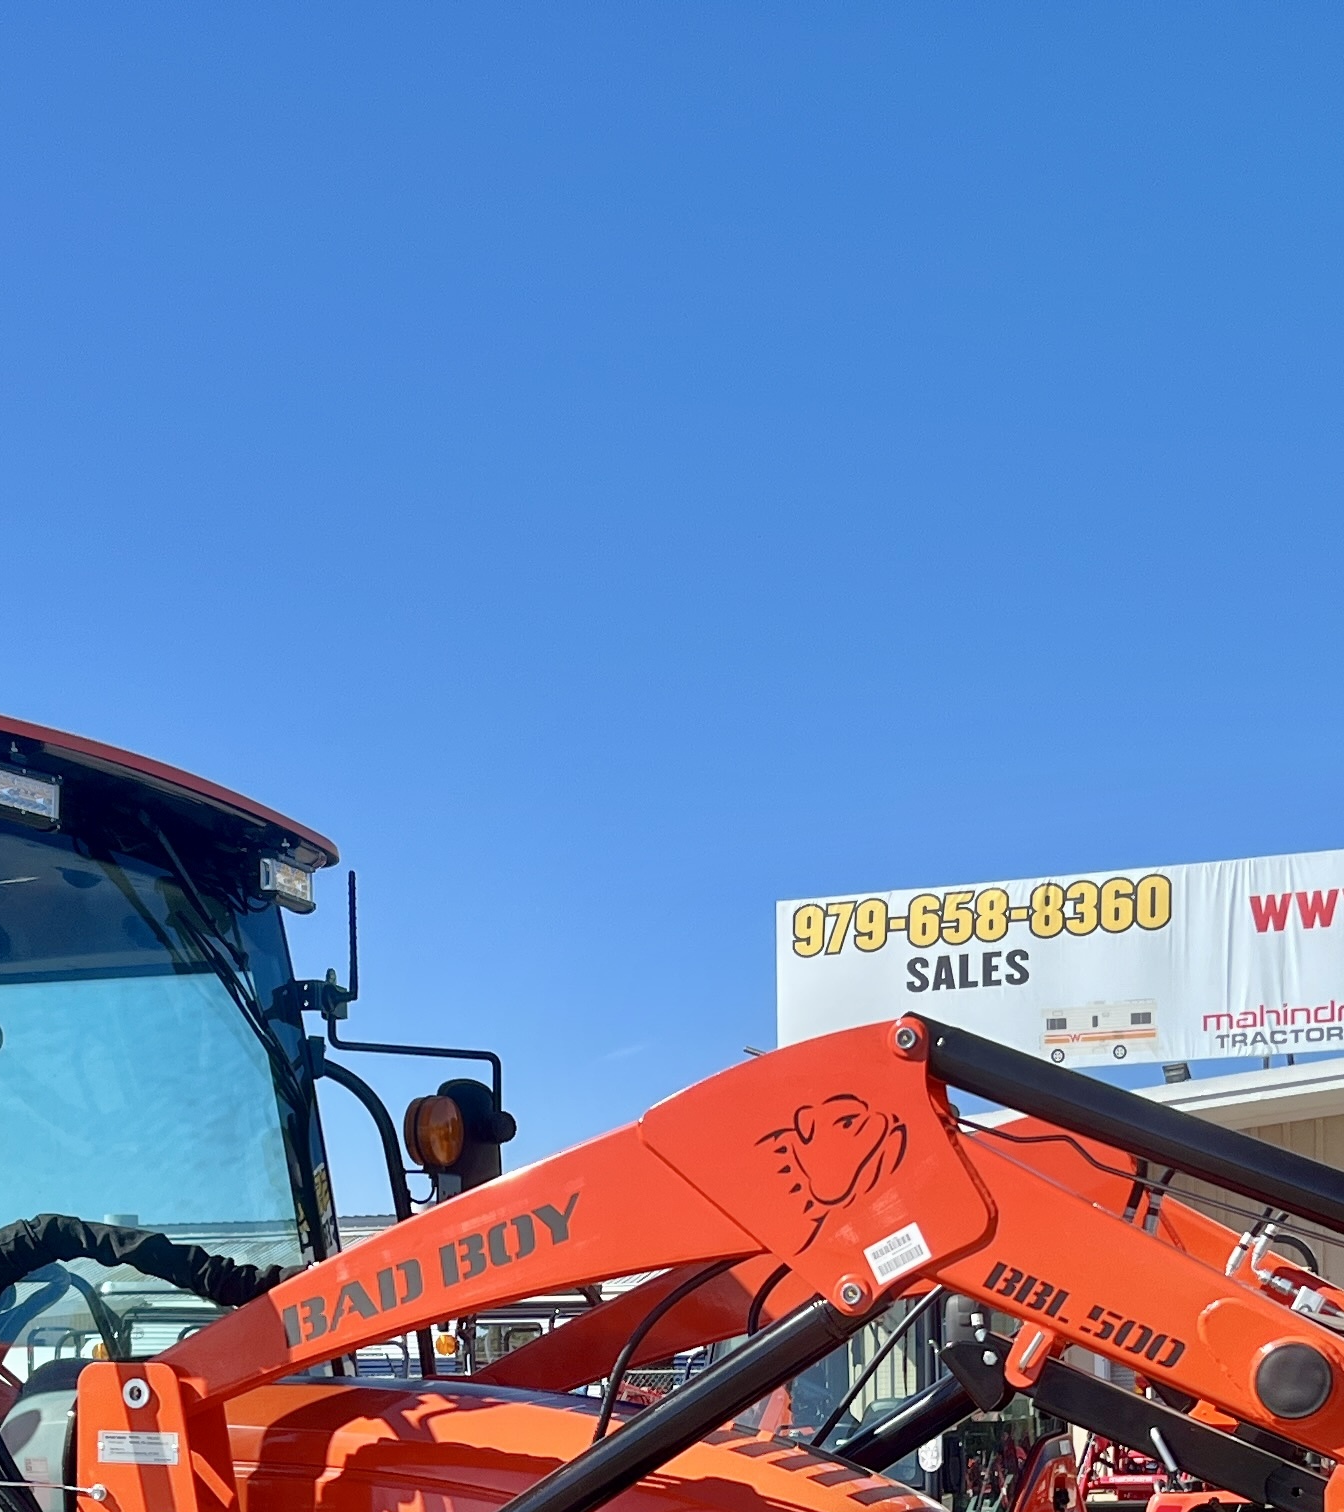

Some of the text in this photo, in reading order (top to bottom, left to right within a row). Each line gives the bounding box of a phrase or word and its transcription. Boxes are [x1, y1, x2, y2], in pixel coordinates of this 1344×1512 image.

[792, 874, 1172, 958] 979-658-8360
[906, 950, 1029, 993] SALES
[281, 1192, 579, 1349] BAD BOY
[981, 1261, 1186, 1368] BBL 500
